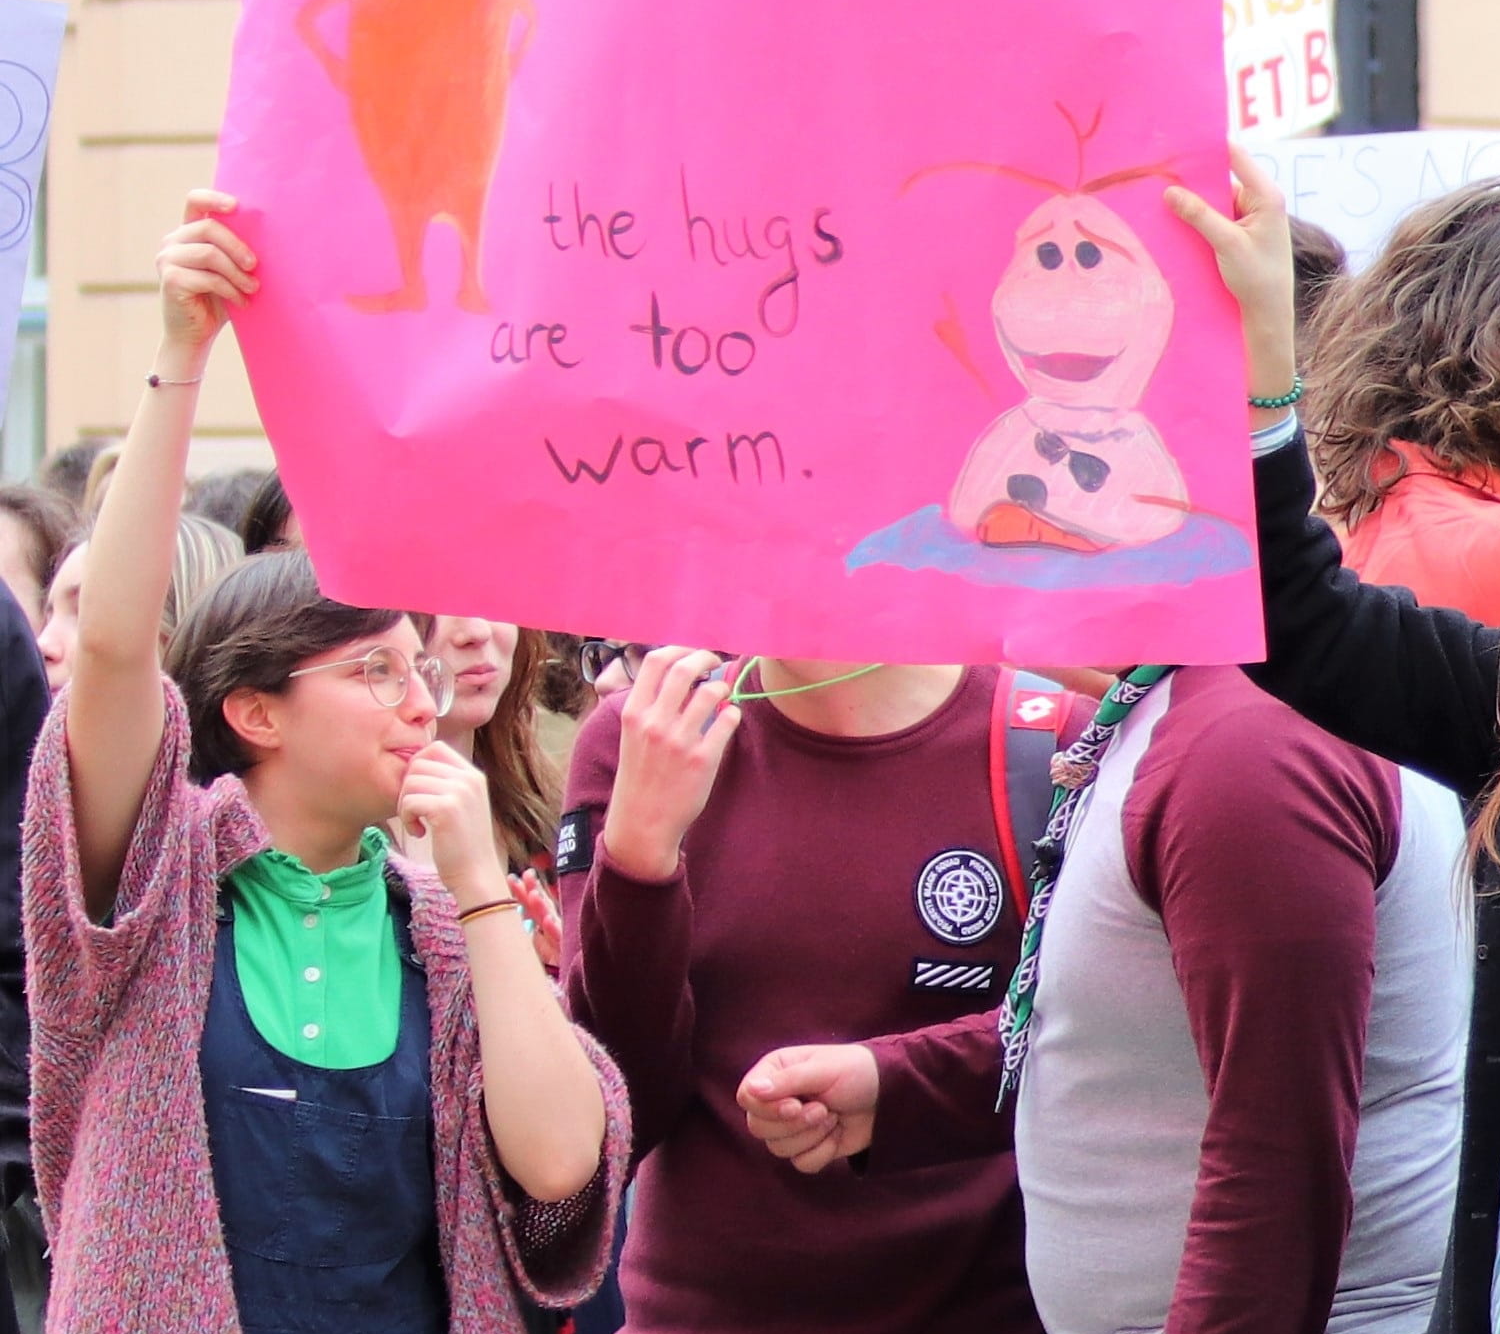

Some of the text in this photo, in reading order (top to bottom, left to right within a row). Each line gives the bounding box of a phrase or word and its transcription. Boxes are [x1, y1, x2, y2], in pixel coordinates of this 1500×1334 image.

[544, 162, 845, 341] the hugs
[489, 292, 757, 378] are too
[543, 430, 815, 485] warm.
